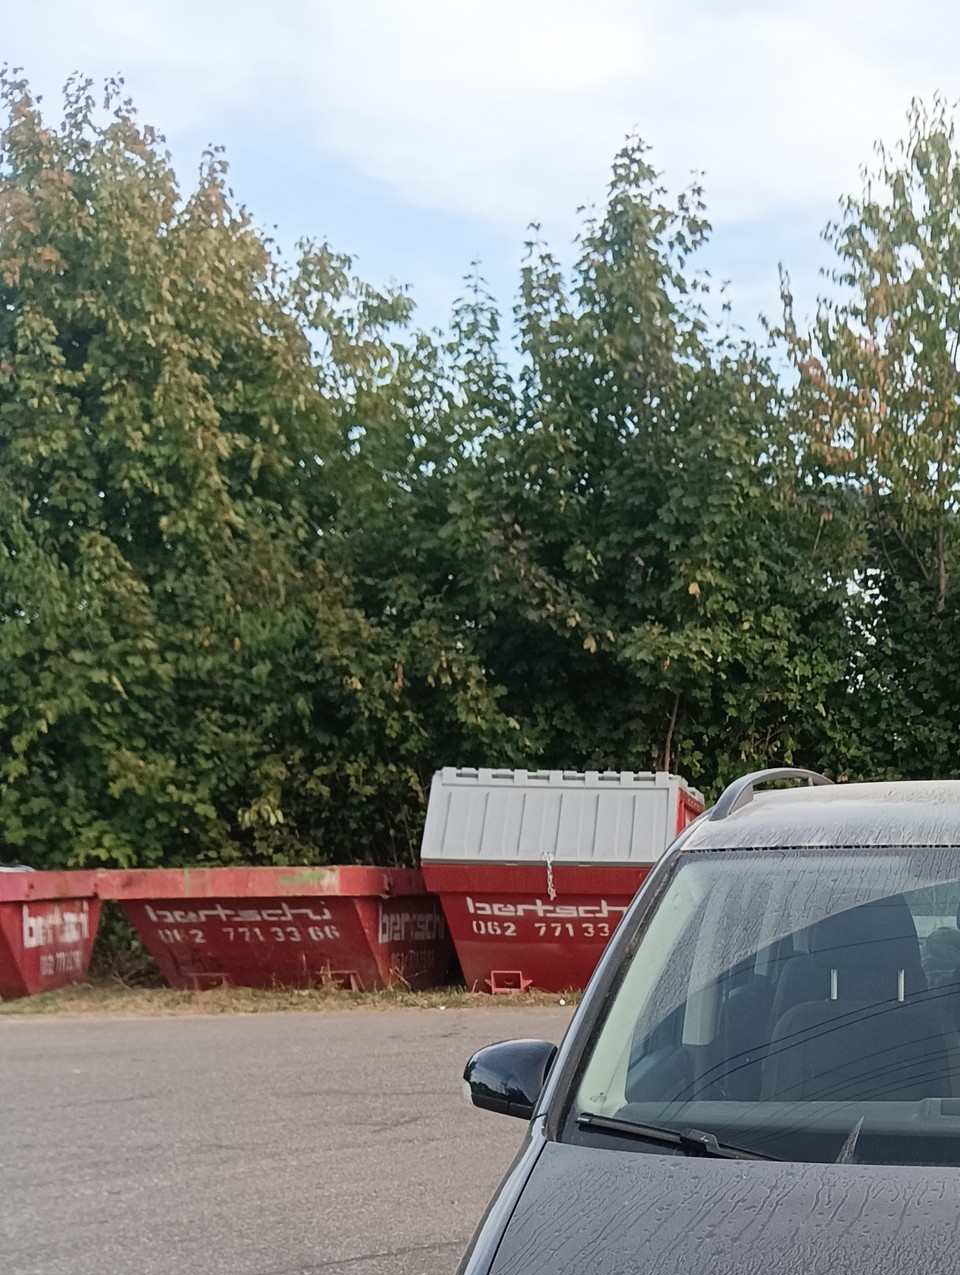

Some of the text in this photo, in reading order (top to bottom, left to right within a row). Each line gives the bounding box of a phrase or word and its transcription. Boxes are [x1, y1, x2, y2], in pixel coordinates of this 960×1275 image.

[145, 901, 333, 923] bertschi
[466, 896, 629, 918] bertsch
[223, 927, 265, 943] 771
[270, 926, 302, 943] 33
[308, 924, 341, 942] 66
[472, 920, 611, 938] 062 771 33
